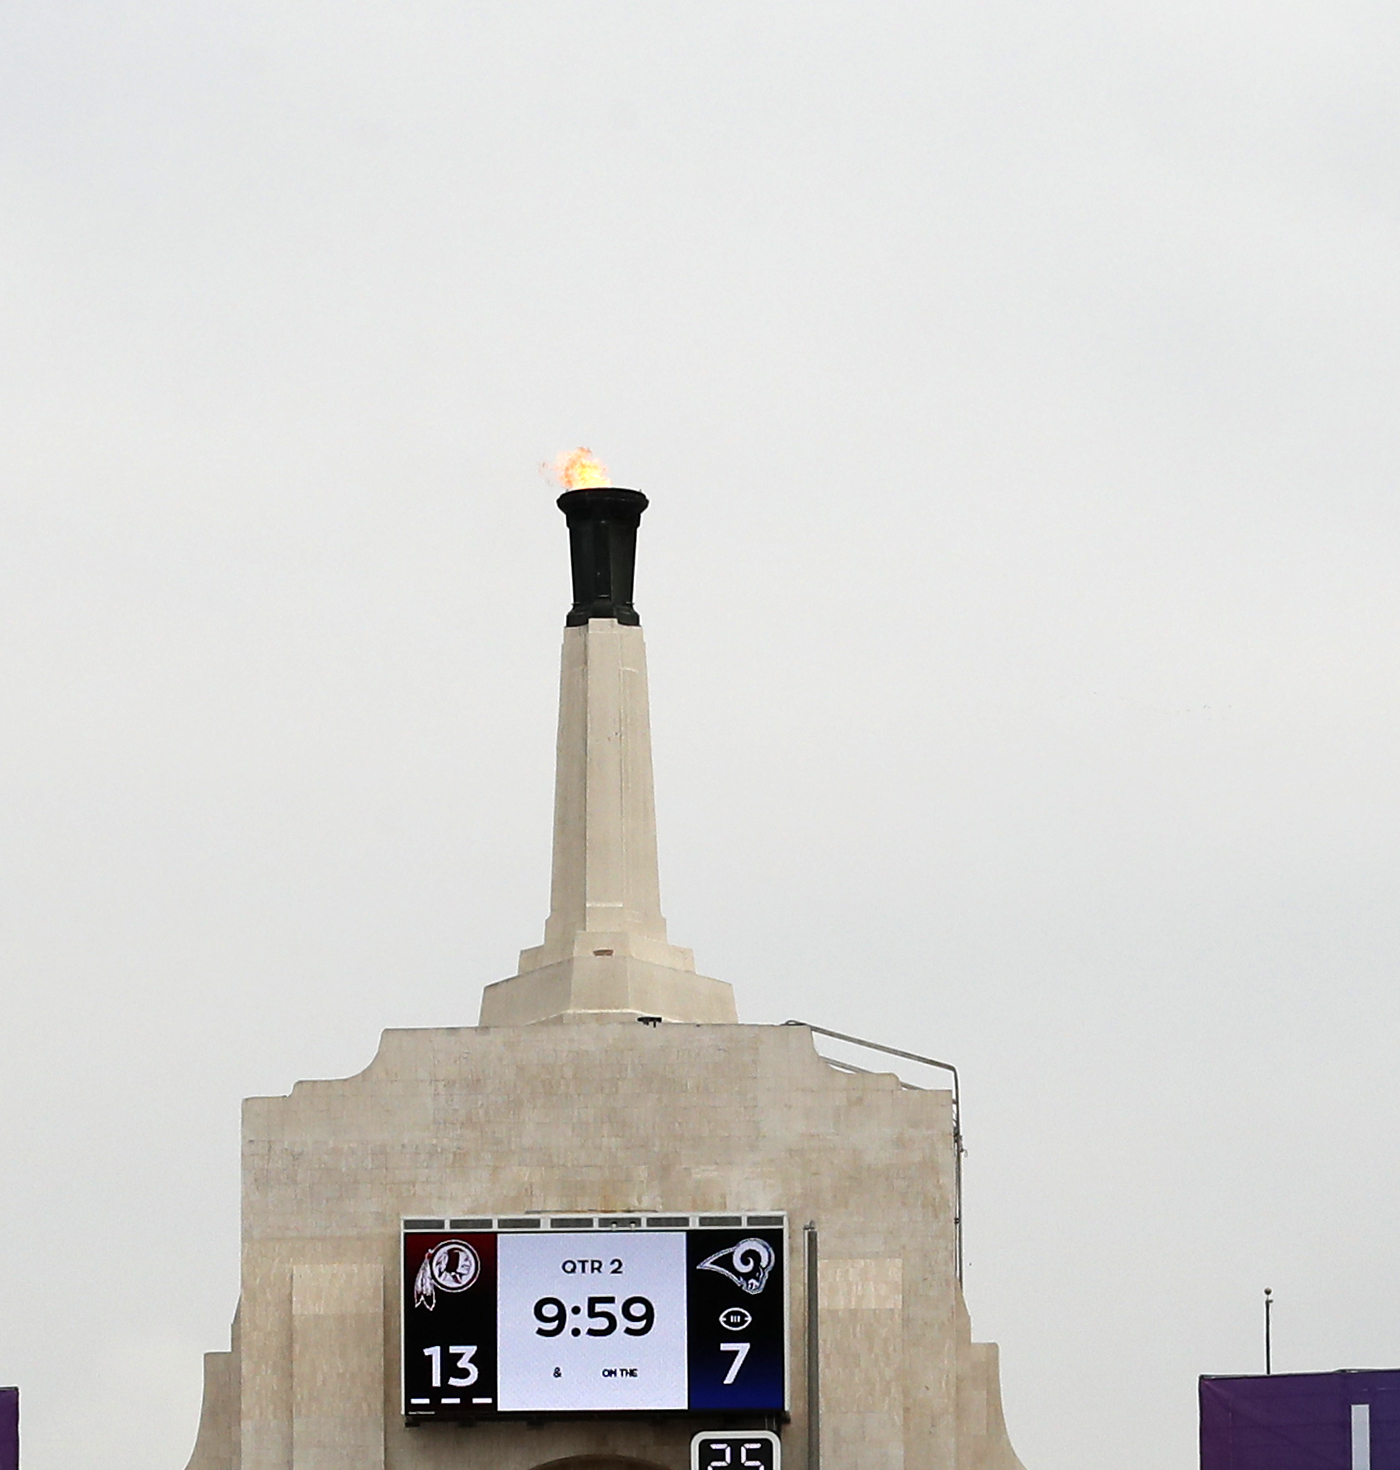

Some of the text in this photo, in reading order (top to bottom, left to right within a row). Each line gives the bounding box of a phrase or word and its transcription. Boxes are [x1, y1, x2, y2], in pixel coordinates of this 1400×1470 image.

[561, 1258, 623, 1275] QTR 2
[533, 1295, 656, 1338] 9:59
[422, 1344, 479, 1388] 13
[719, 1342, 751, 1386] 7
